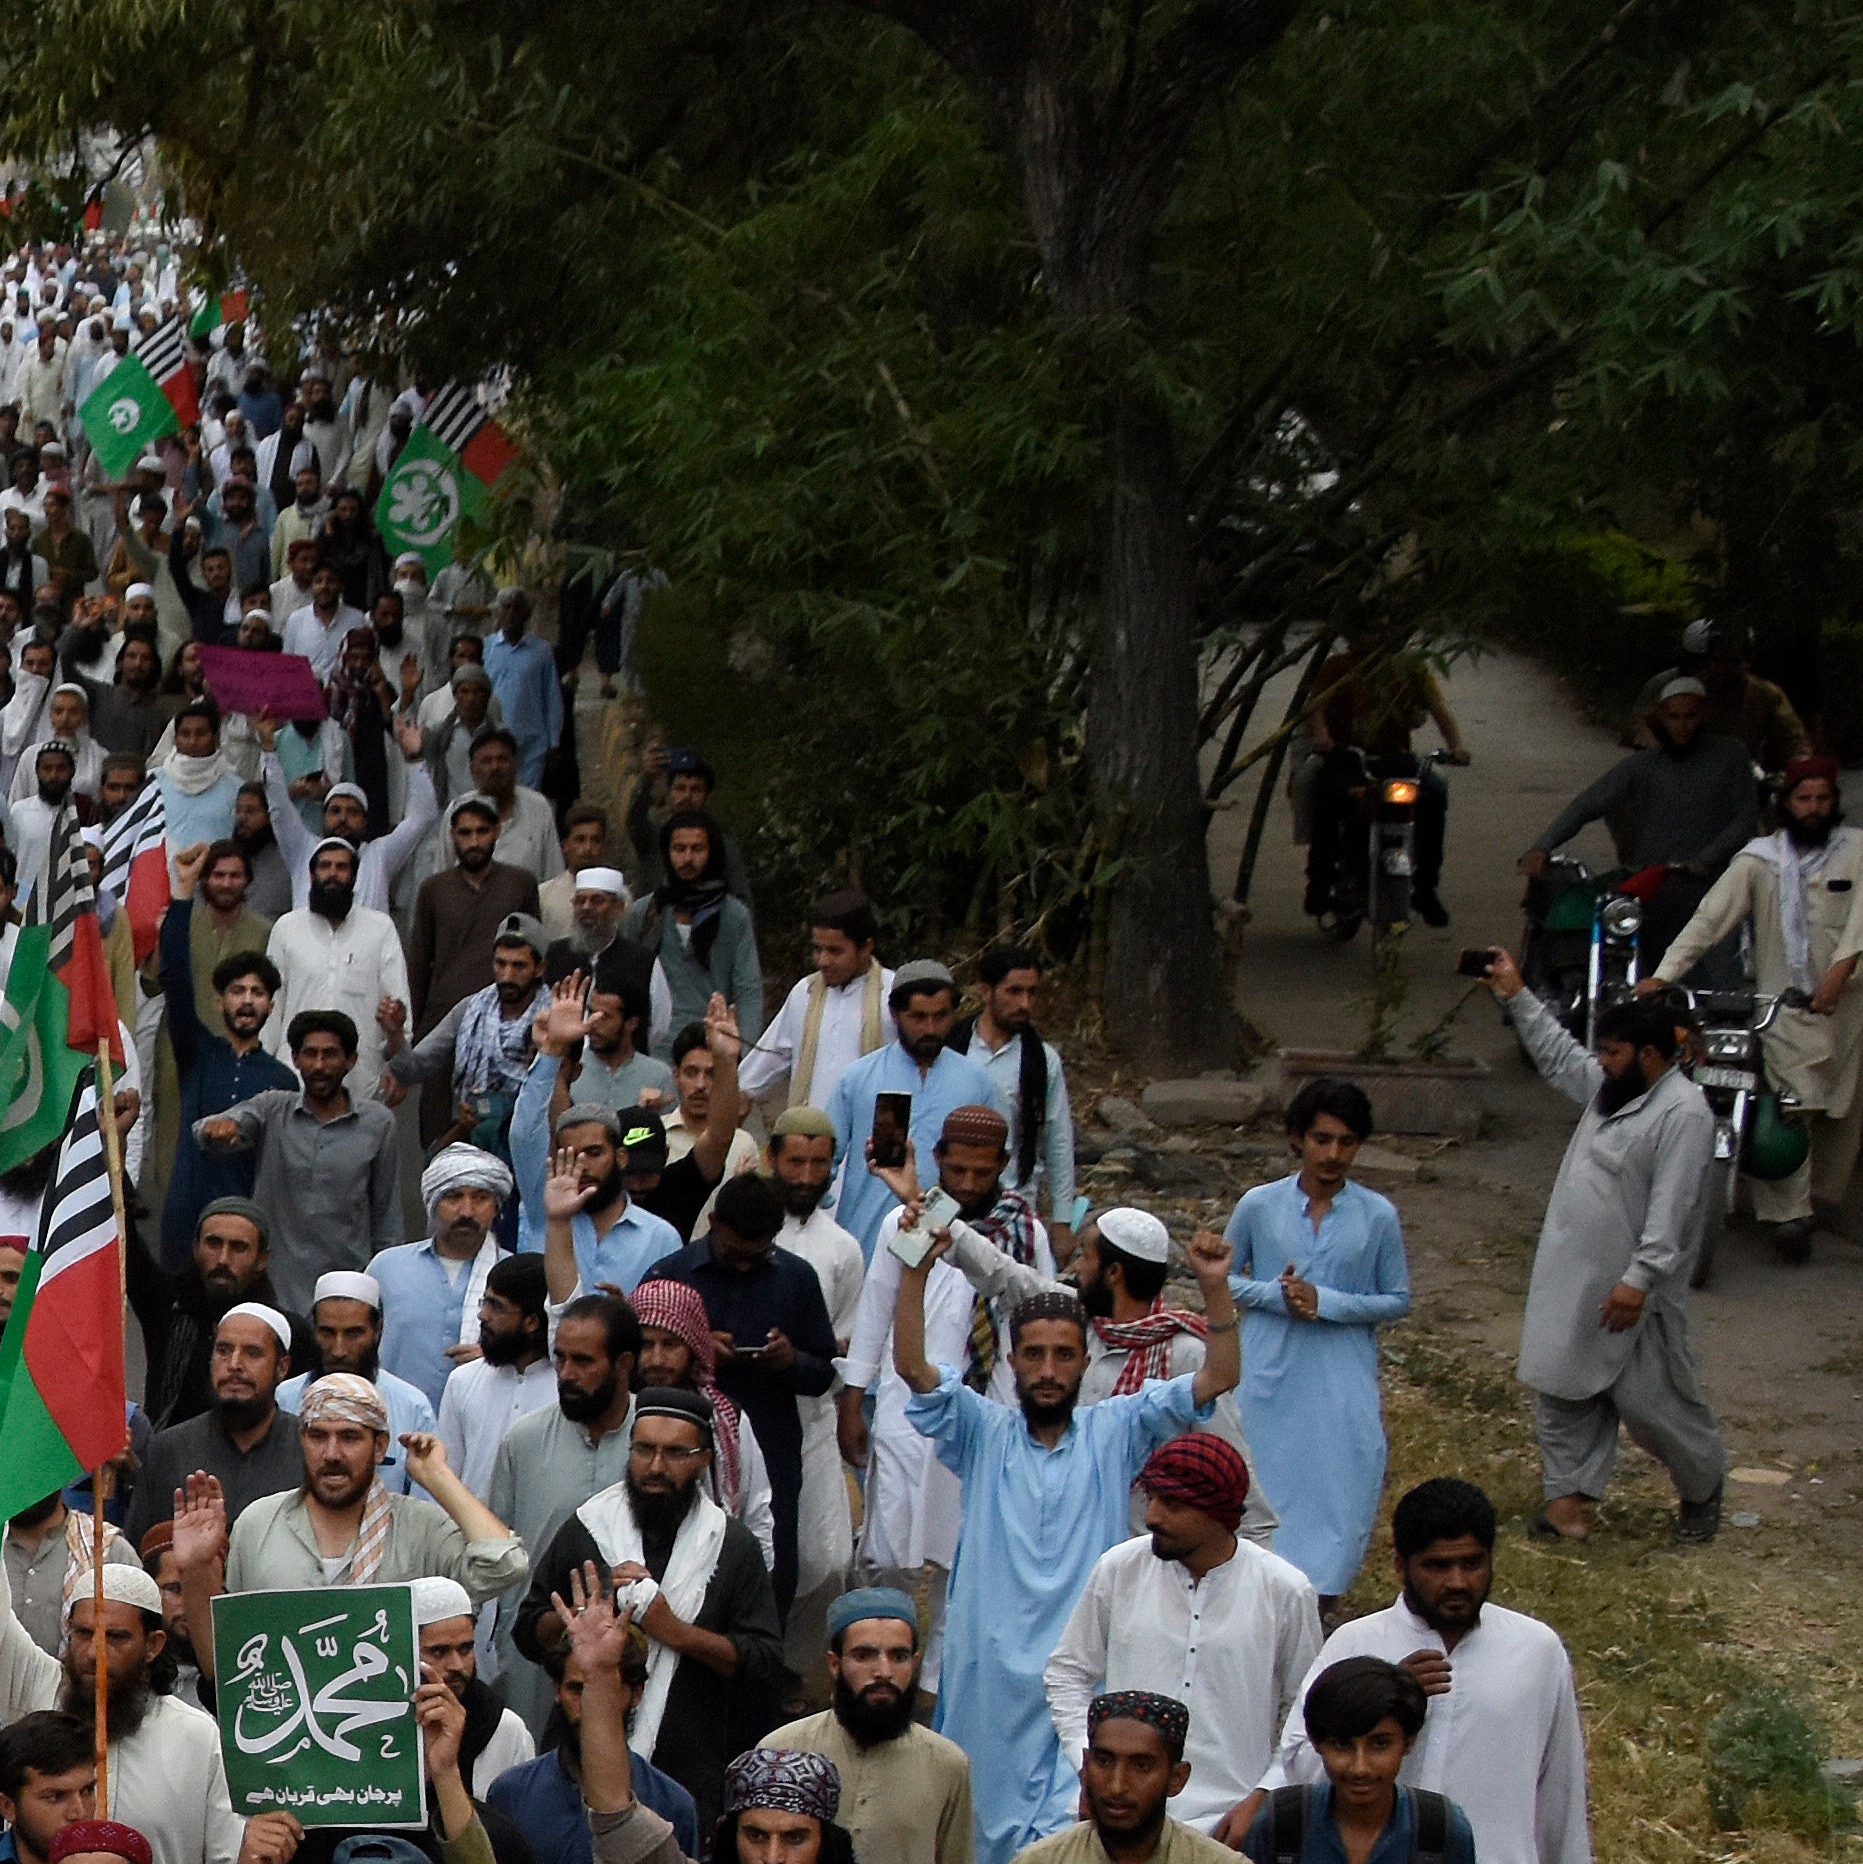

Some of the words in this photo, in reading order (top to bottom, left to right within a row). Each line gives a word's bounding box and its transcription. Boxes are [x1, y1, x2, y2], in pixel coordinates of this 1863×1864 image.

[275, 1784, 315, 1807] قربان
[316, 1786, 355, 1806] بھی
[356, 1784, 386, 1805] جان
[384, 1788, 403, 1808] پر
